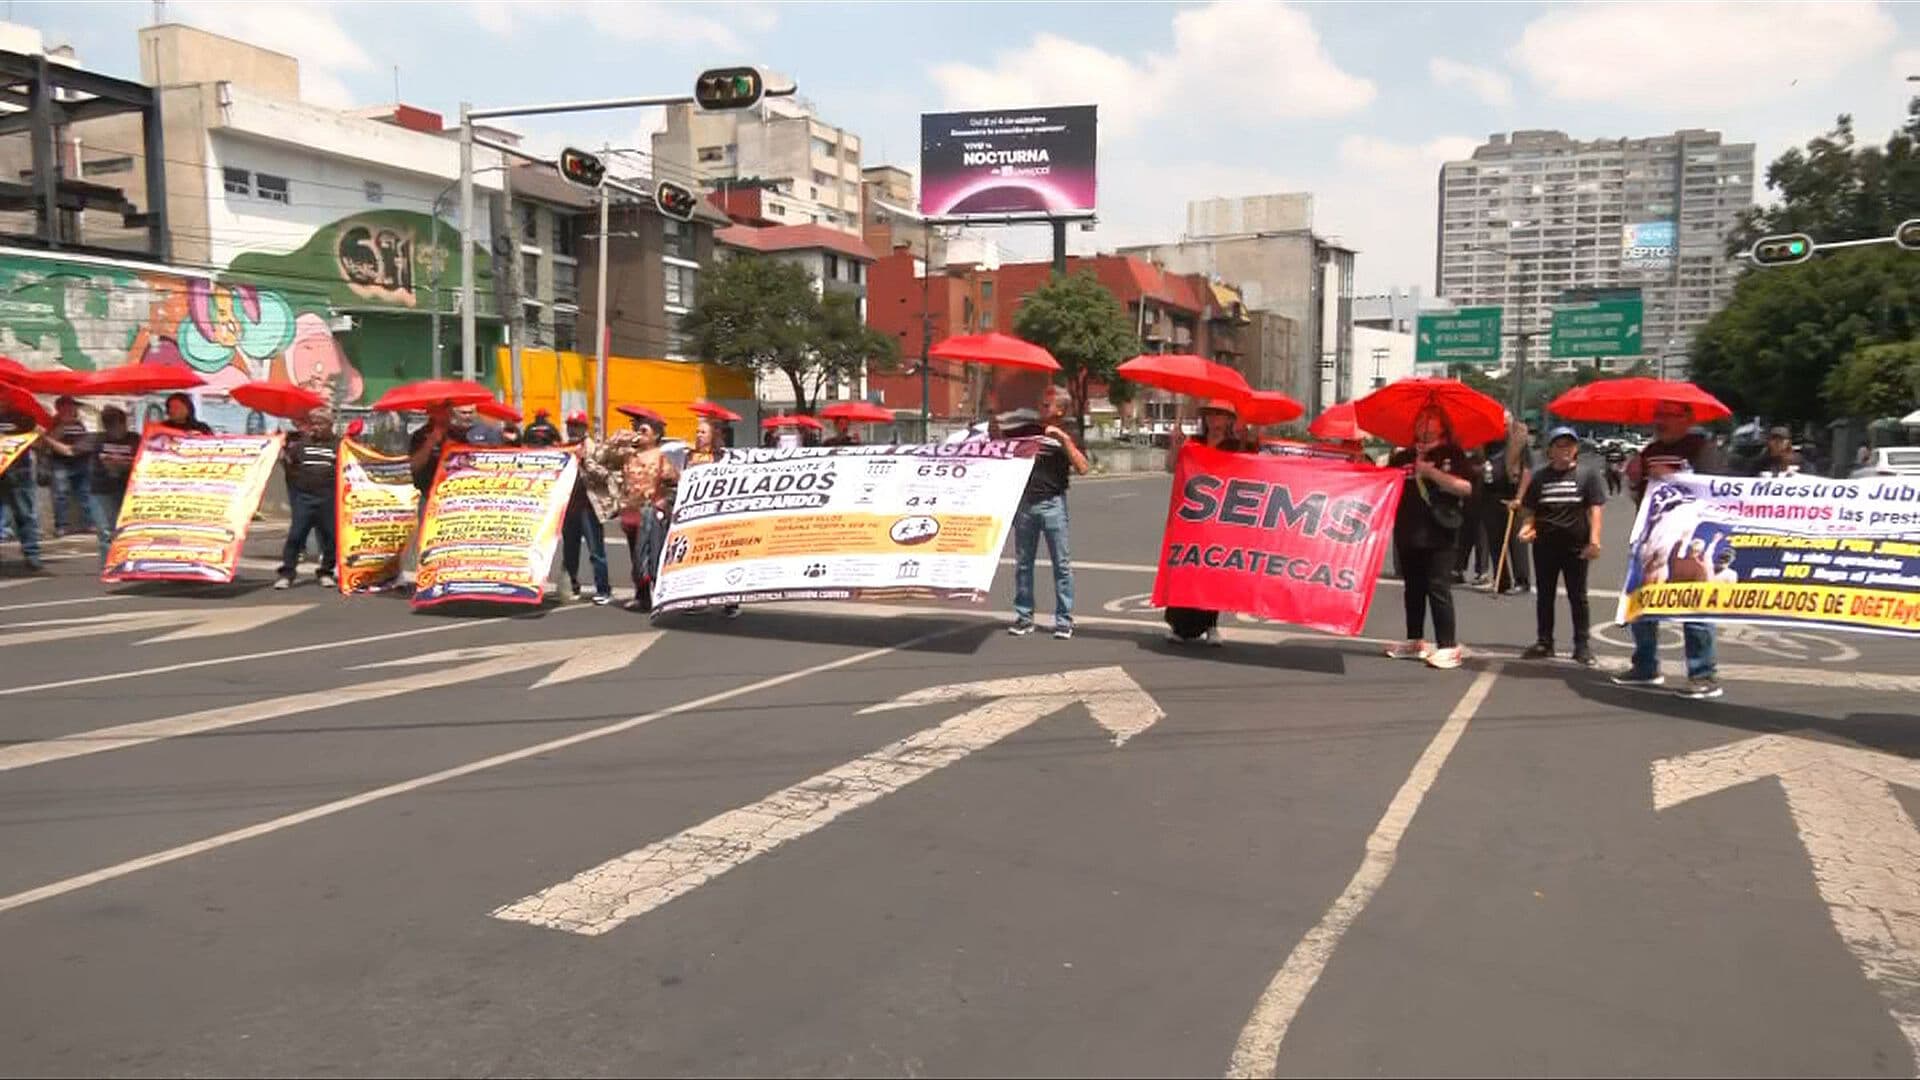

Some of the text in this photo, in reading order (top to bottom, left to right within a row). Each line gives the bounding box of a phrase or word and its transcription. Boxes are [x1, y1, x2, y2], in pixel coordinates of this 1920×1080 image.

[963, 149, 1050, 166] NOCTURNA
[681, 471, 838, 506] JUBILADOS
[1709, 479, 1744, 497] Los
[1750, 481, 1860, 499] Maestros
[1176, 474, 1373, 545] SEMS
[1837, 505, 1865, 522] las
[1167, 543, 1358, 591] ZACATECAS
[1782, 564, 1811, 578] NO
[1706, 588, 1719, 608] A
[1722, 588, 1819, 613] JUBILADOS
[1822, 593, 1846, 614] DE
